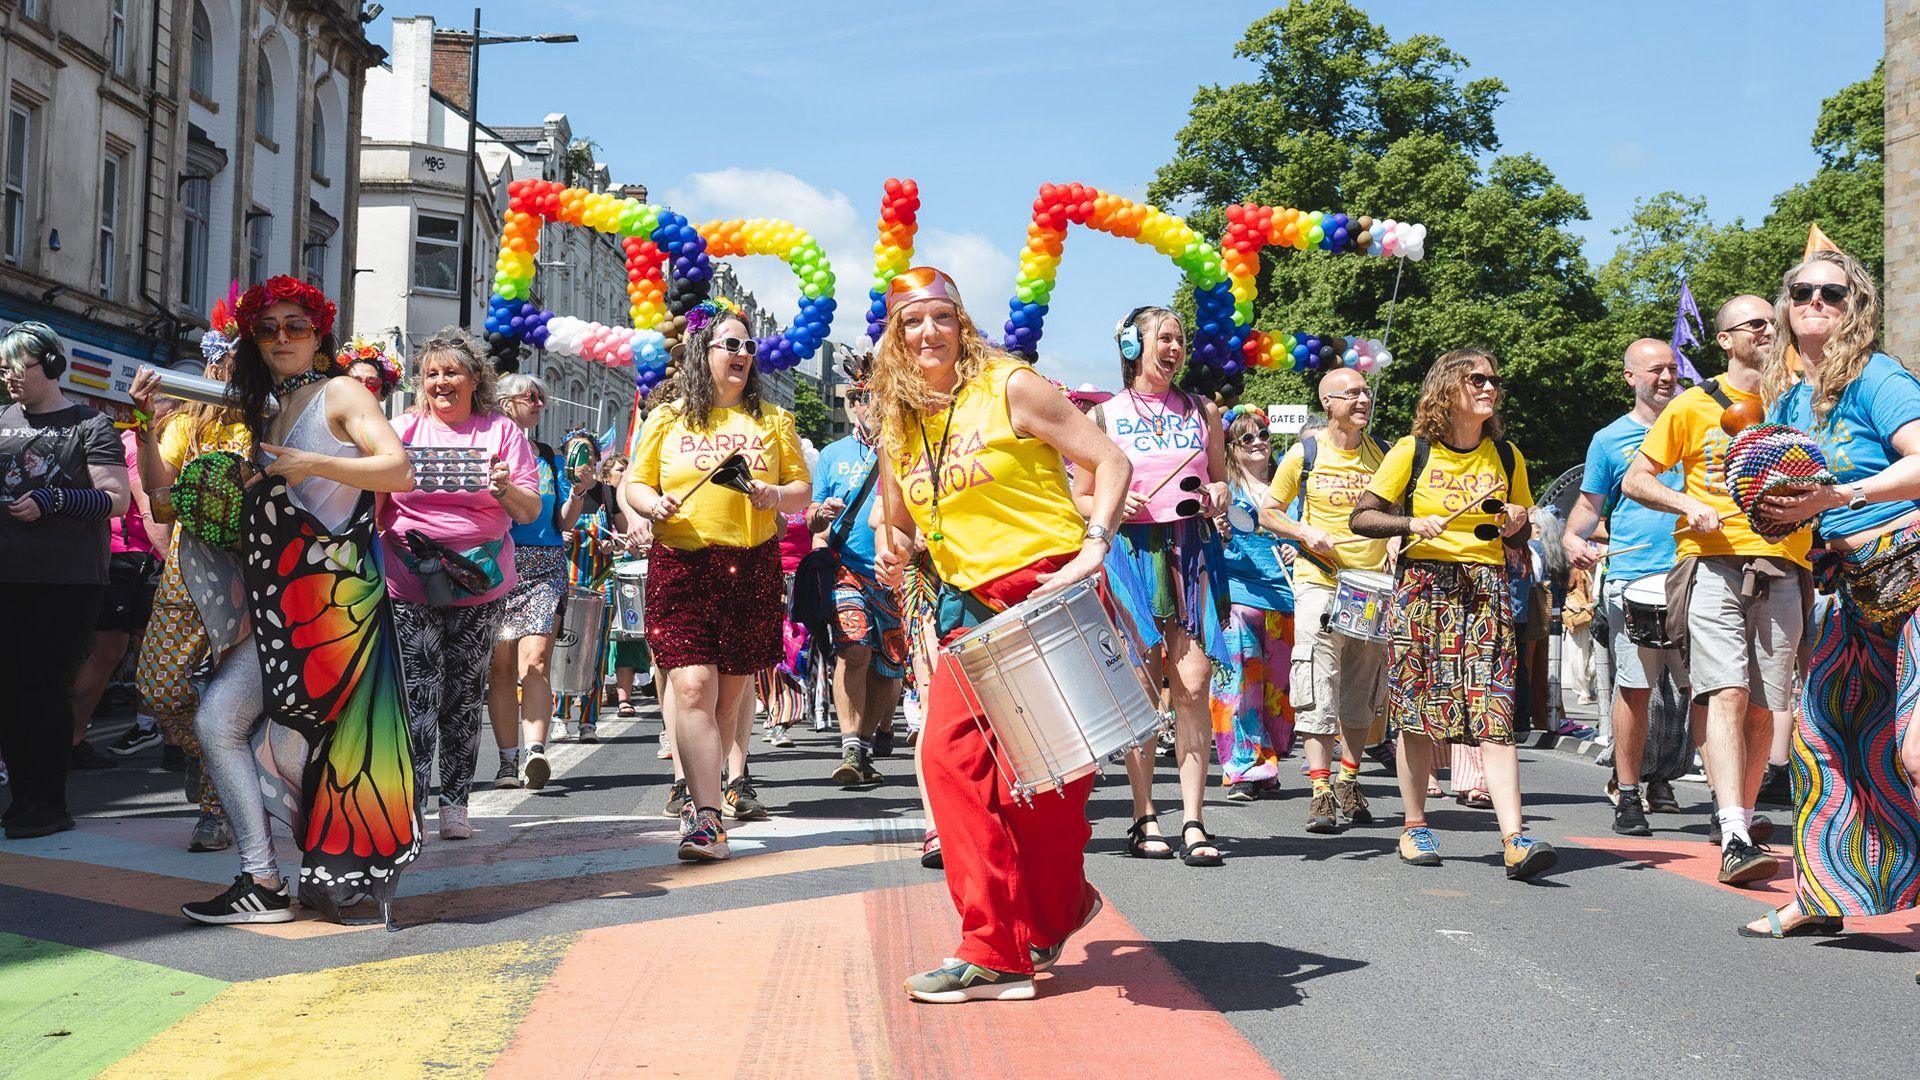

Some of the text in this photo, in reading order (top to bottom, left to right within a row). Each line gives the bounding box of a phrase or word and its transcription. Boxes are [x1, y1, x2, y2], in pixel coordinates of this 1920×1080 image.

[1270, 414, 1305, 424] GATE B
[680, 433, 767, 454] BARRA
[1134, 431, 1205, 452] CWDA
[694, 453, 769, 472] CA
[900, 430, 987, 481] BARRA
[908, 458, 996, 506] CWDA
[1315, 473, 1372, 490] BARR
